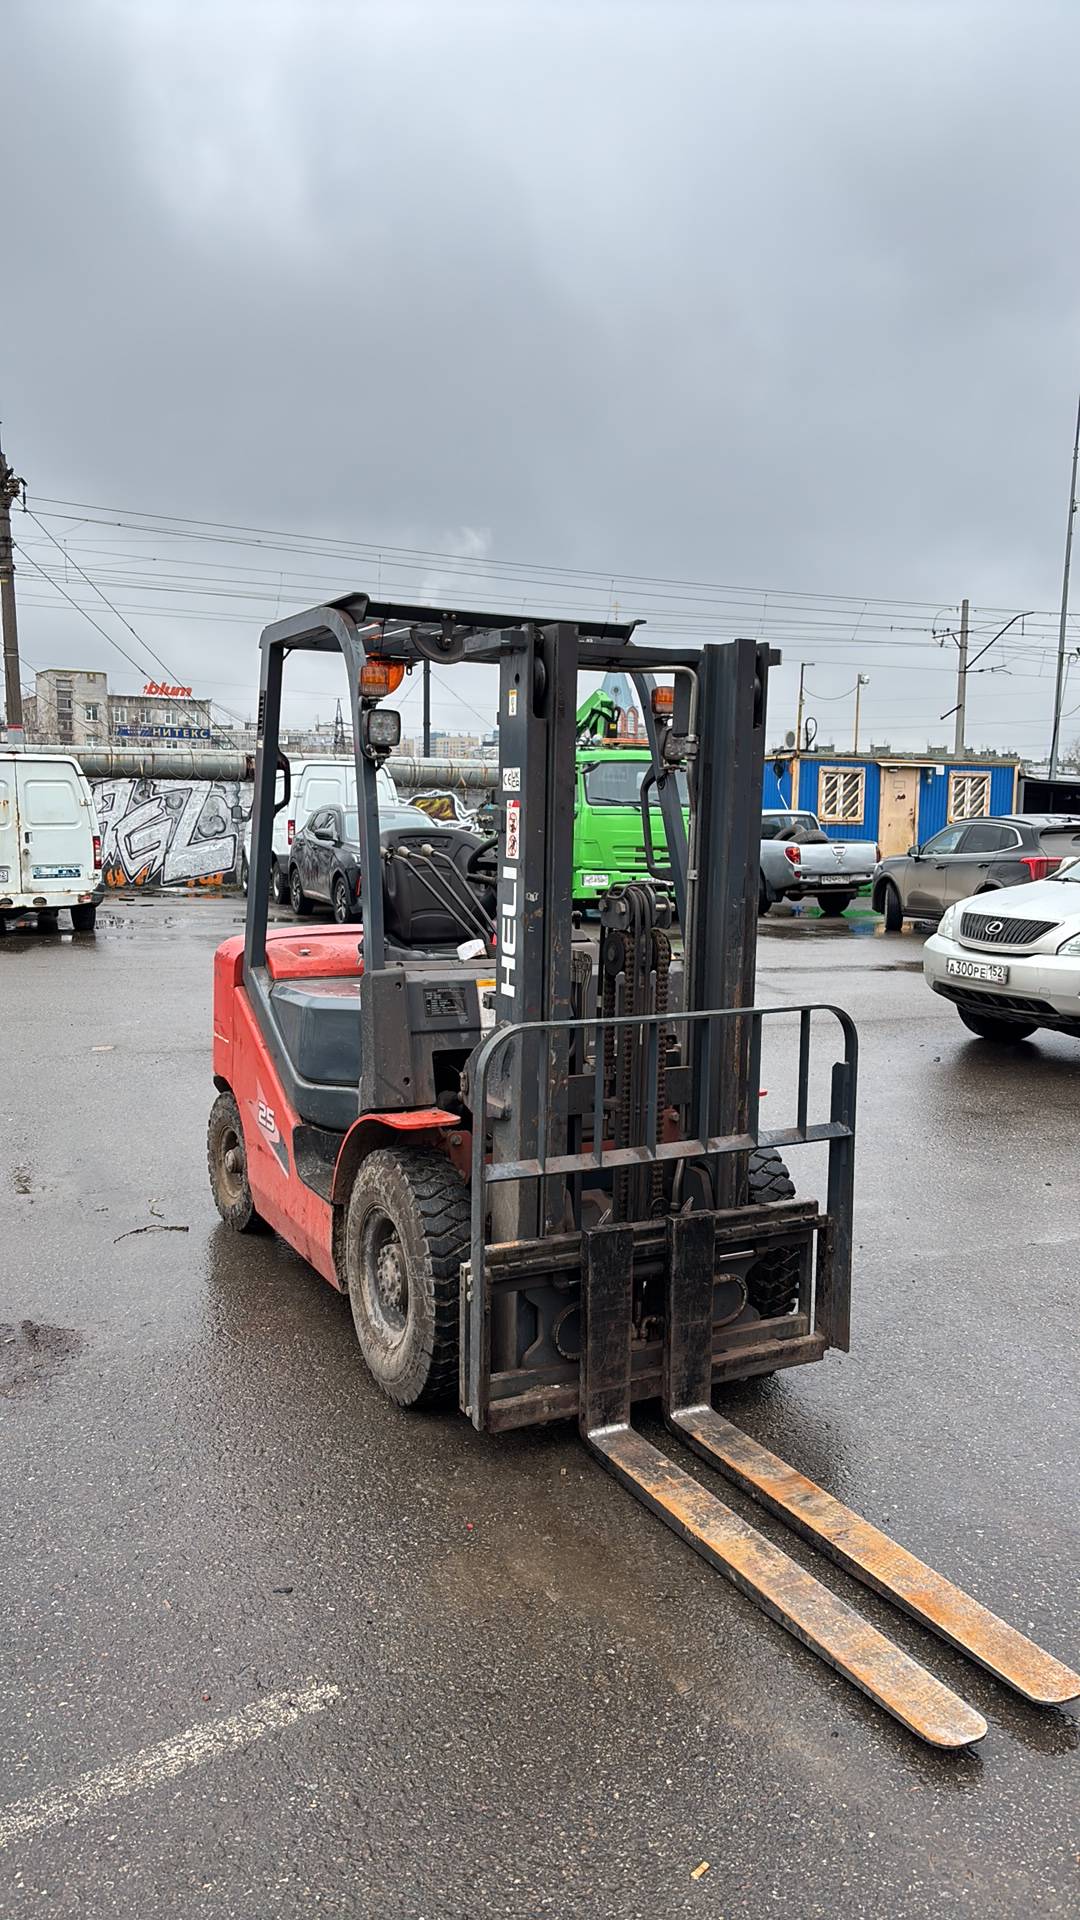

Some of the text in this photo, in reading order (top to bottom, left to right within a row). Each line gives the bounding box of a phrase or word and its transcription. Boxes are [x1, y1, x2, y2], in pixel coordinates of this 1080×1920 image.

[146, 682, 192, 696] blum
[152, 728, 208, 738] НИТЕКС
[501, 866, 517, 998] HELI
[989, 965, 1003, 977] 152
[258, 1100, 275, 1133] 25
